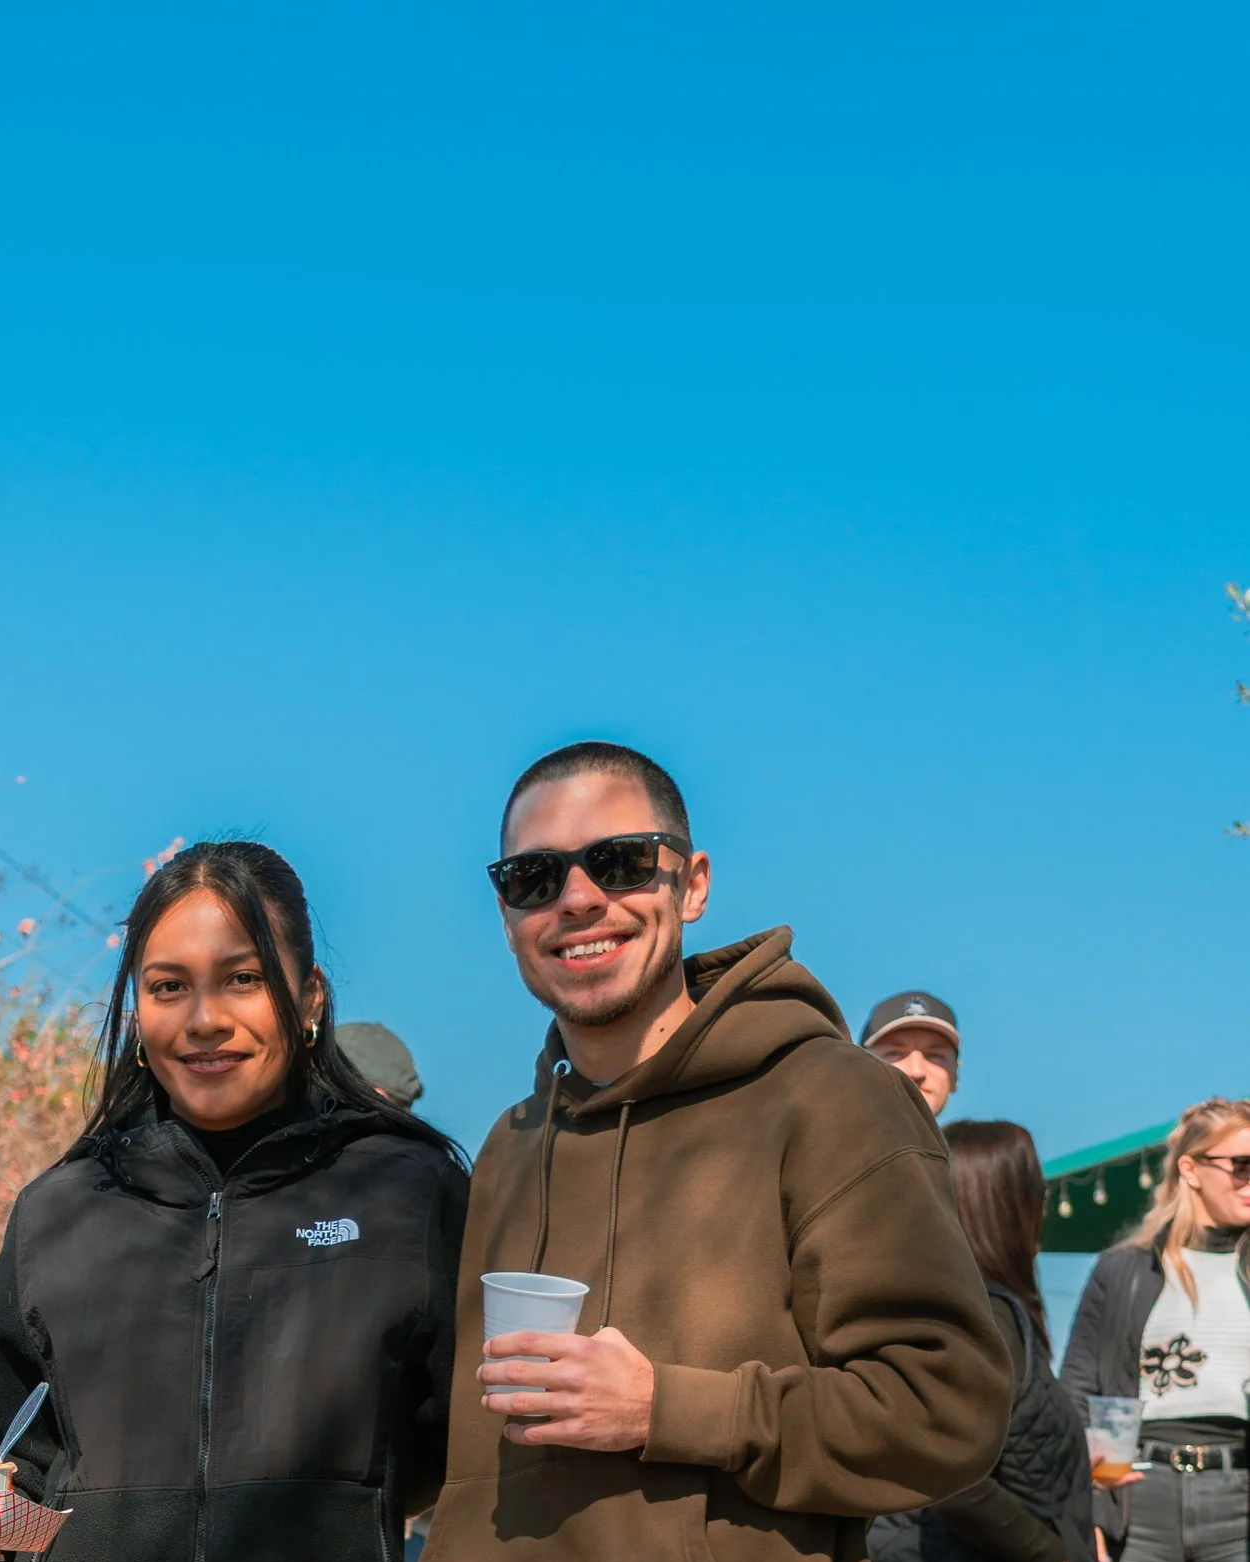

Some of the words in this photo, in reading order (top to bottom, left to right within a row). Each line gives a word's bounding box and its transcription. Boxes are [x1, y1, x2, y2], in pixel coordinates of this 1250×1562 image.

[314, 1221, 338, 1231] THE
[295, 1228, 338, 1239] NORTH
[307, 1236, 339, 1247] FACE
